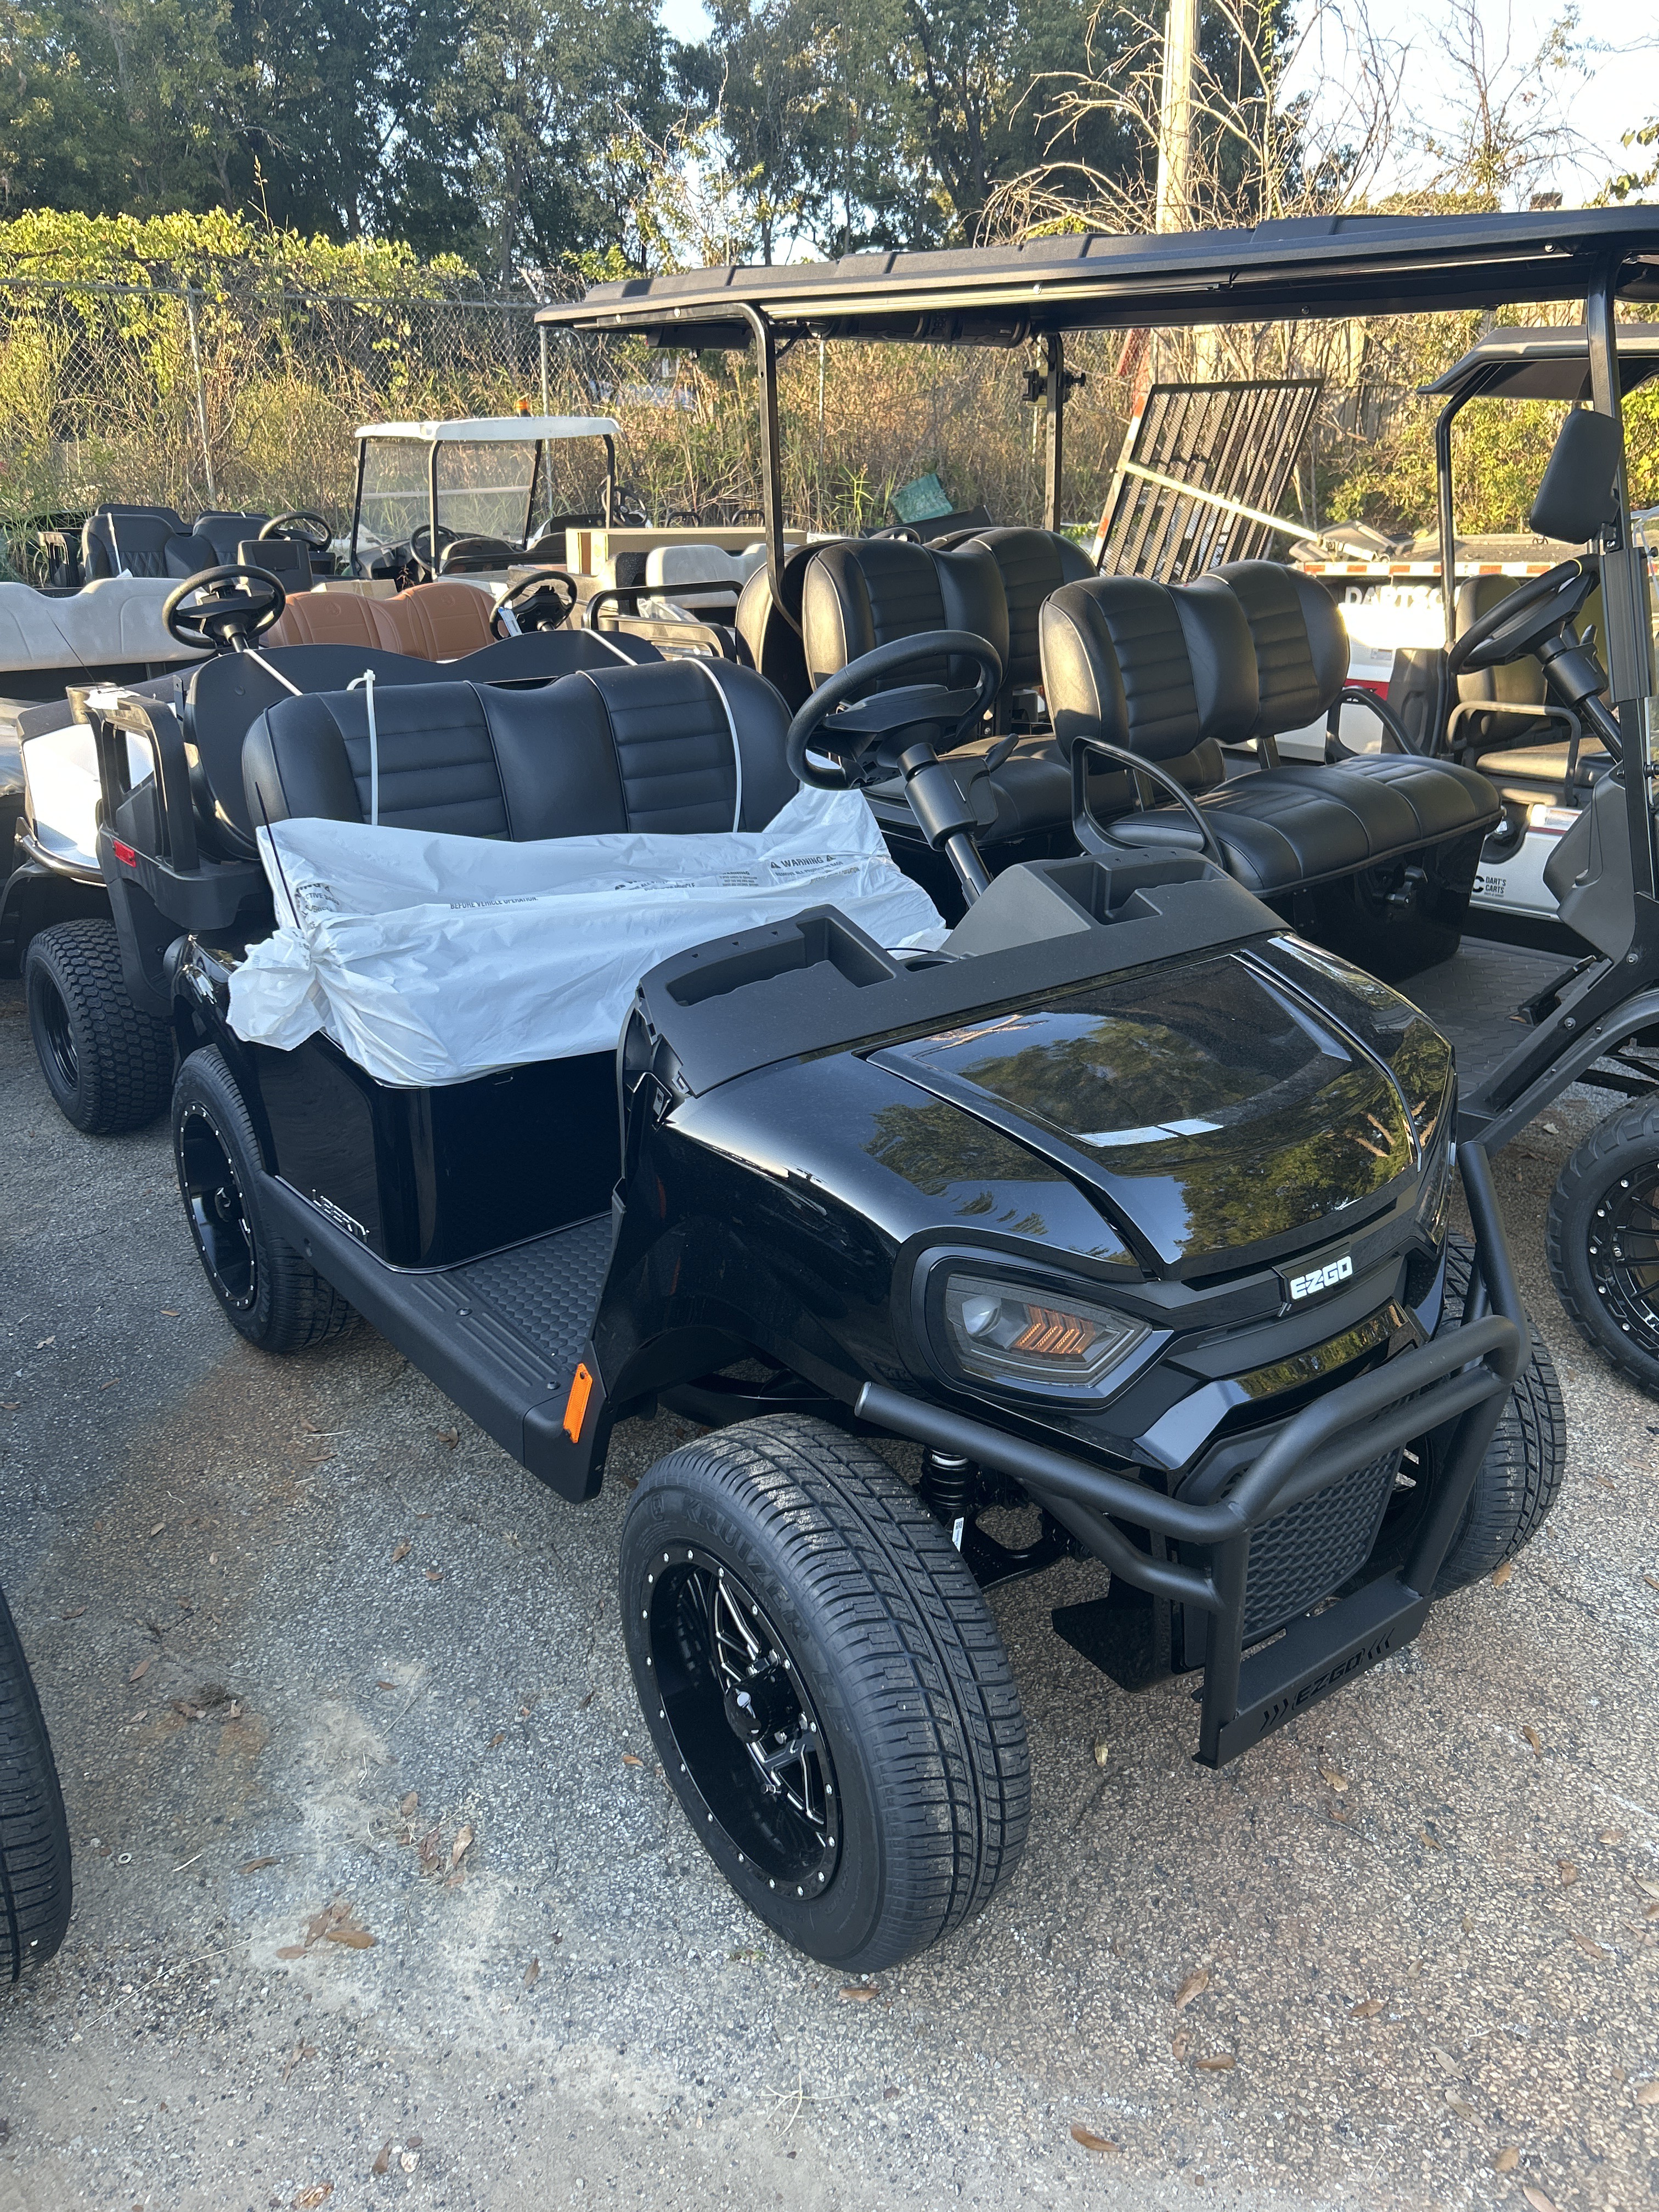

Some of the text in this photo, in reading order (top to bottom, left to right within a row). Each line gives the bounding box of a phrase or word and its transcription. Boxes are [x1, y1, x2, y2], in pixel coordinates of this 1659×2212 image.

[781, 856, 825, 868] WARNING
[1485, 875, 1507, 887] DART'S
[1485, 883, 1505, 894] CARTS
[1290, 1255, 1353, 1300] EZGO
[1294, 1650, 1364, 1707] EZGO
